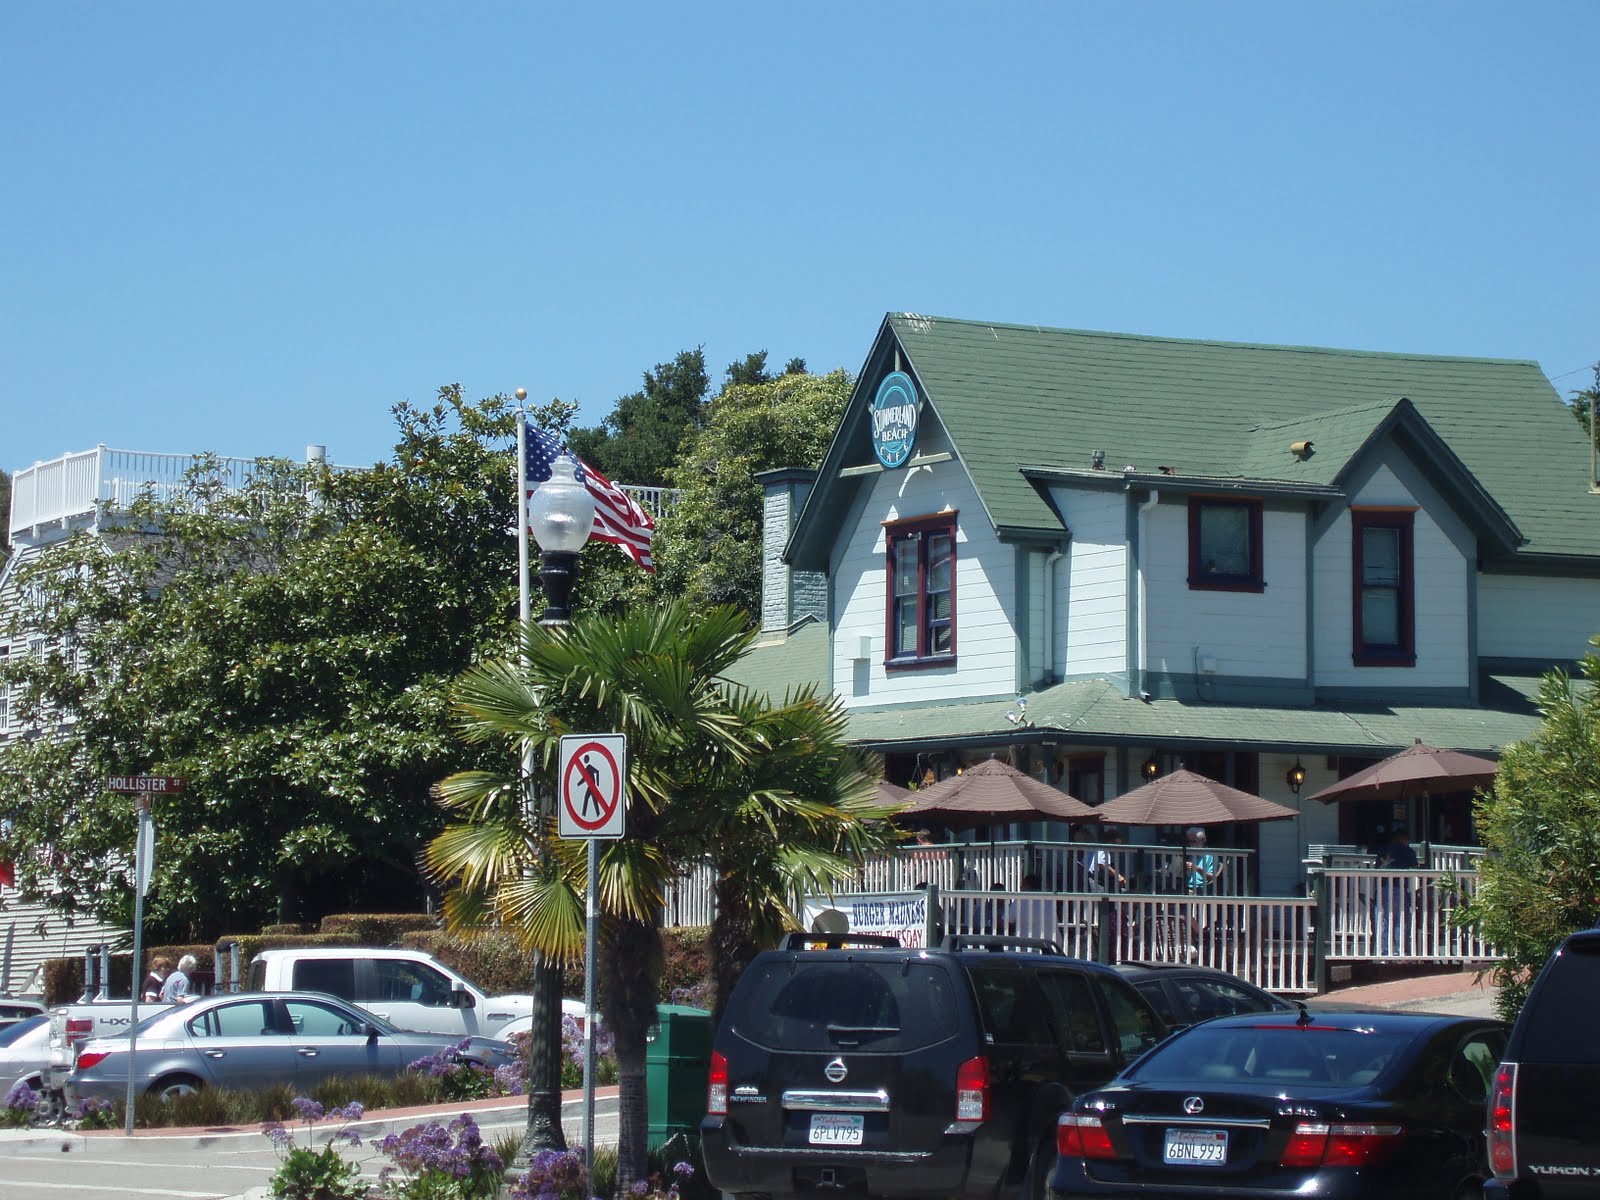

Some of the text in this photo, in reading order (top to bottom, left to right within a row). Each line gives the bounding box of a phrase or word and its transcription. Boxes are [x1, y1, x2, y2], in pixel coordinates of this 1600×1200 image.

[874, 404, 917, 438] SUMMERLAND
[881, 427, 908, 442] BEACH
[108, 777, 167, 791] HOLLISTER
[852, 900, 925, 927] BURGER MADNESS
[730, 1095, 767, 1103] PATHFINDER
[813, 1125, 860, 1141] 6PLV795
[1168, 1142, 1223, 1160] 6BNL993
[1528, 1165, 1590, 1176] YUKON
